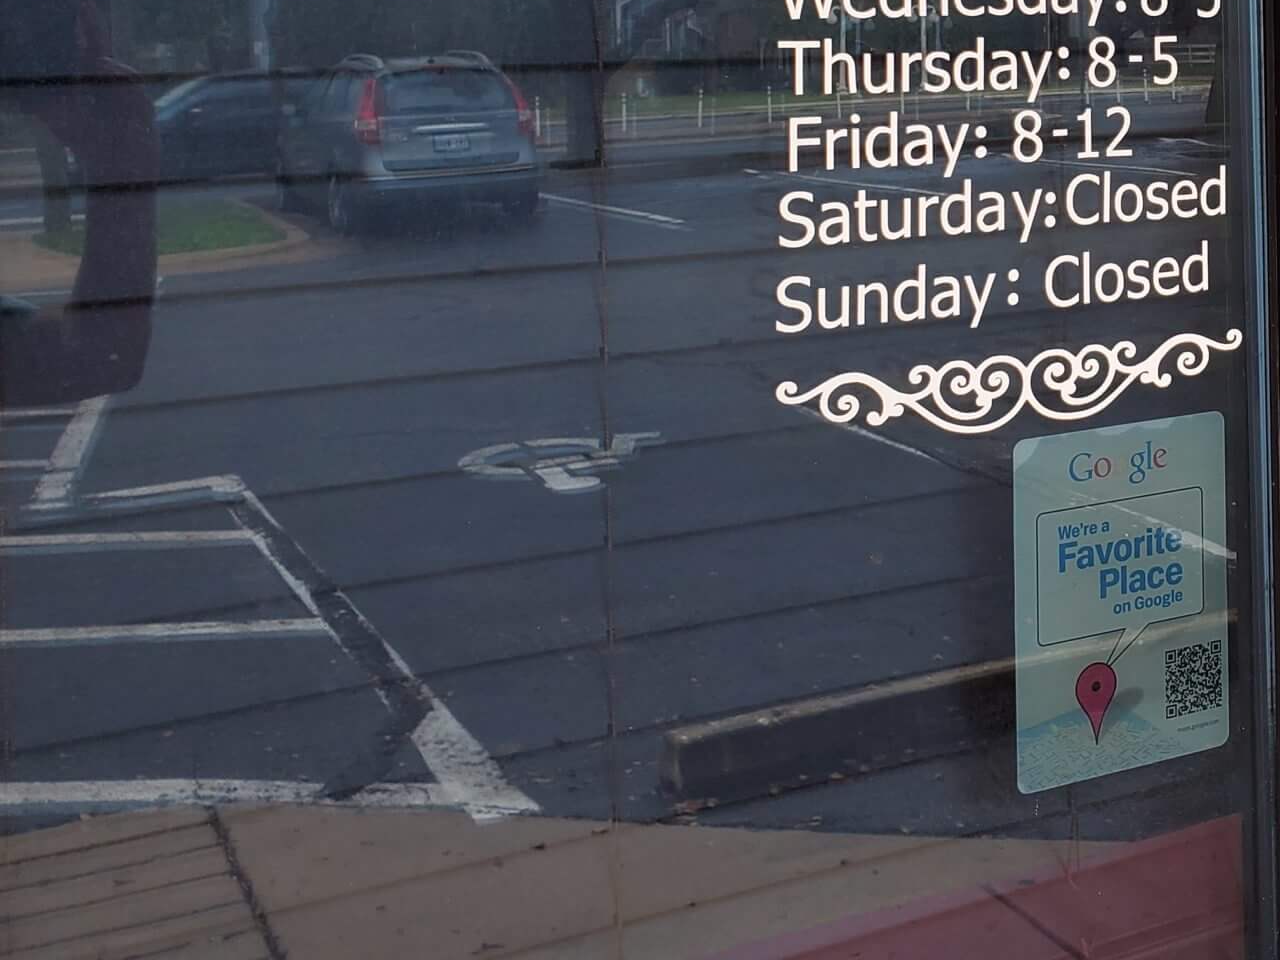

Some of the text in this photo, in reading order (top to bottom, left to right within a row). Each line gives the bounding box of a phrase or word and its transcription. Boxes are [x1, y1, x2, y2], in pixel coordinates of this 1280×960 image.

[778, 37, 1071, 102] Thursday:
[787, 111, 988, 178] Friday:
[778, 165, 1227, 248] Saturday: Closed
[1045, 240, 1209, 308] Closed
[1057, 521, 1110, 541] We're a
[1058, 526, 1184, 573] Favorite
[1100, 561, 1184, 600] Place
[1113, 589, 1184, 616] on Google
